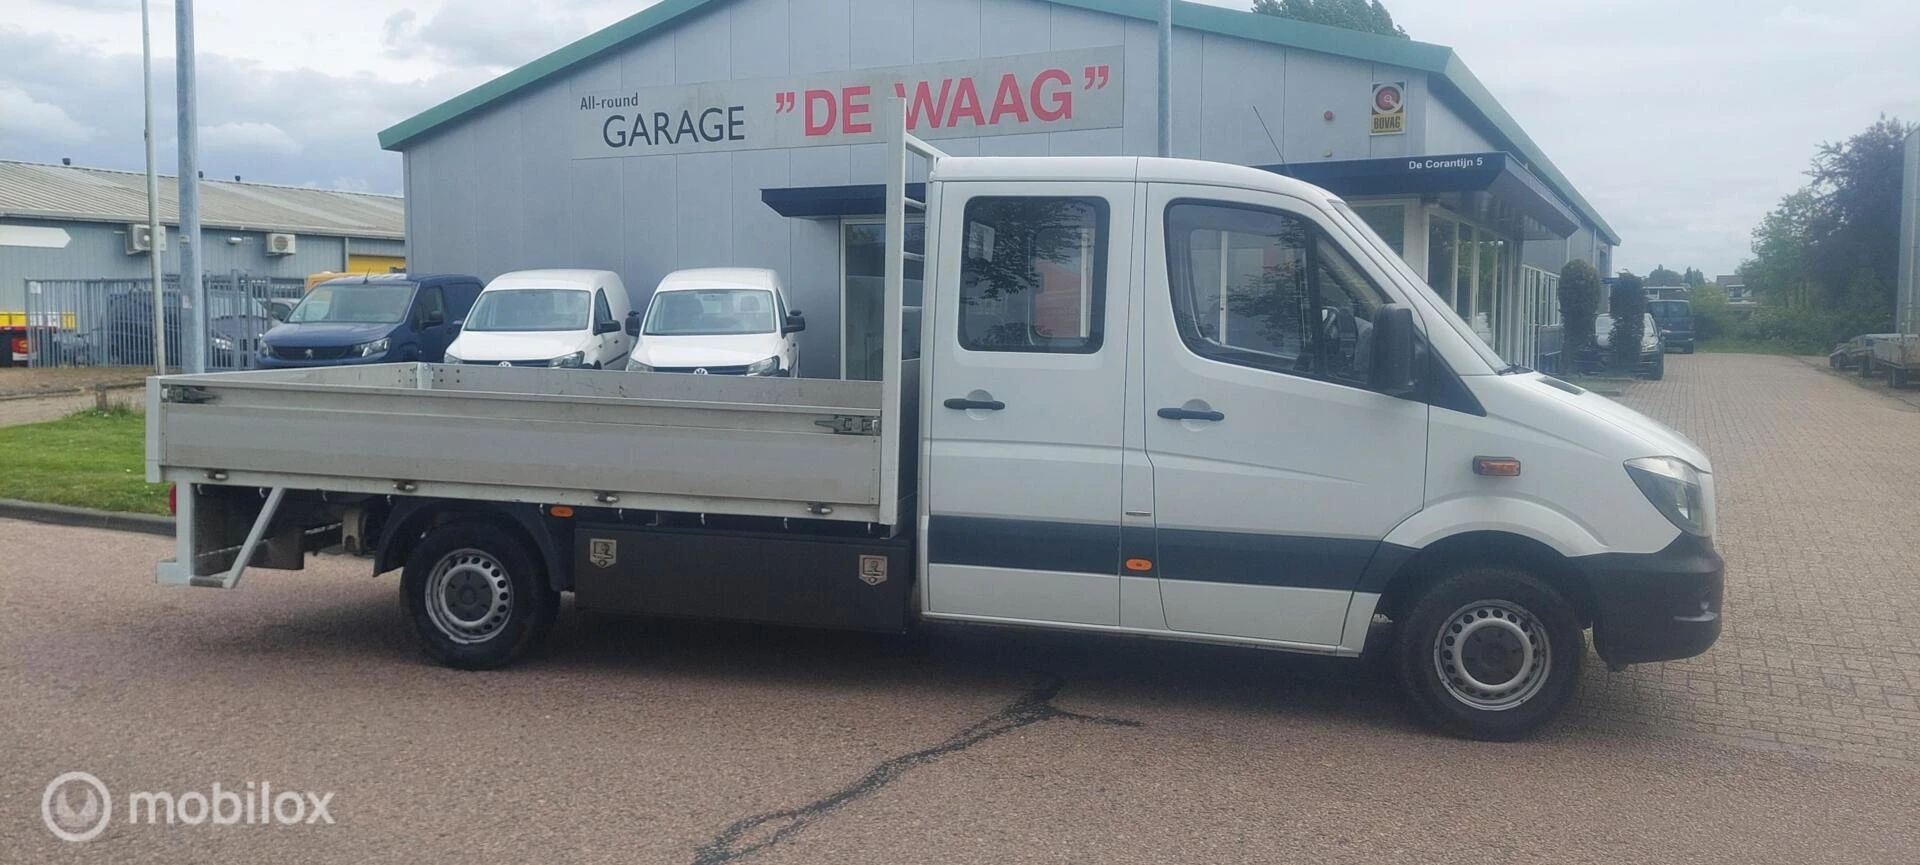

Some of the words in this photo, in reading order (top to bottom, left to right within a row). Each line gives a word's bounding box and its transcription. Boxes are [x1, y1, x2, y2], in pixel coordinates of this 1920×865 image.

[580, 92, 639, 110] All-round
[602, 105, 746, 148] GARAGE
[1374, 116, 1401, 129] BOVAG
[1408, 160, 1423, 170] De
[1425, 158, 1474, 169] Corantijn
[1476, 157, 1483, 166] 5
